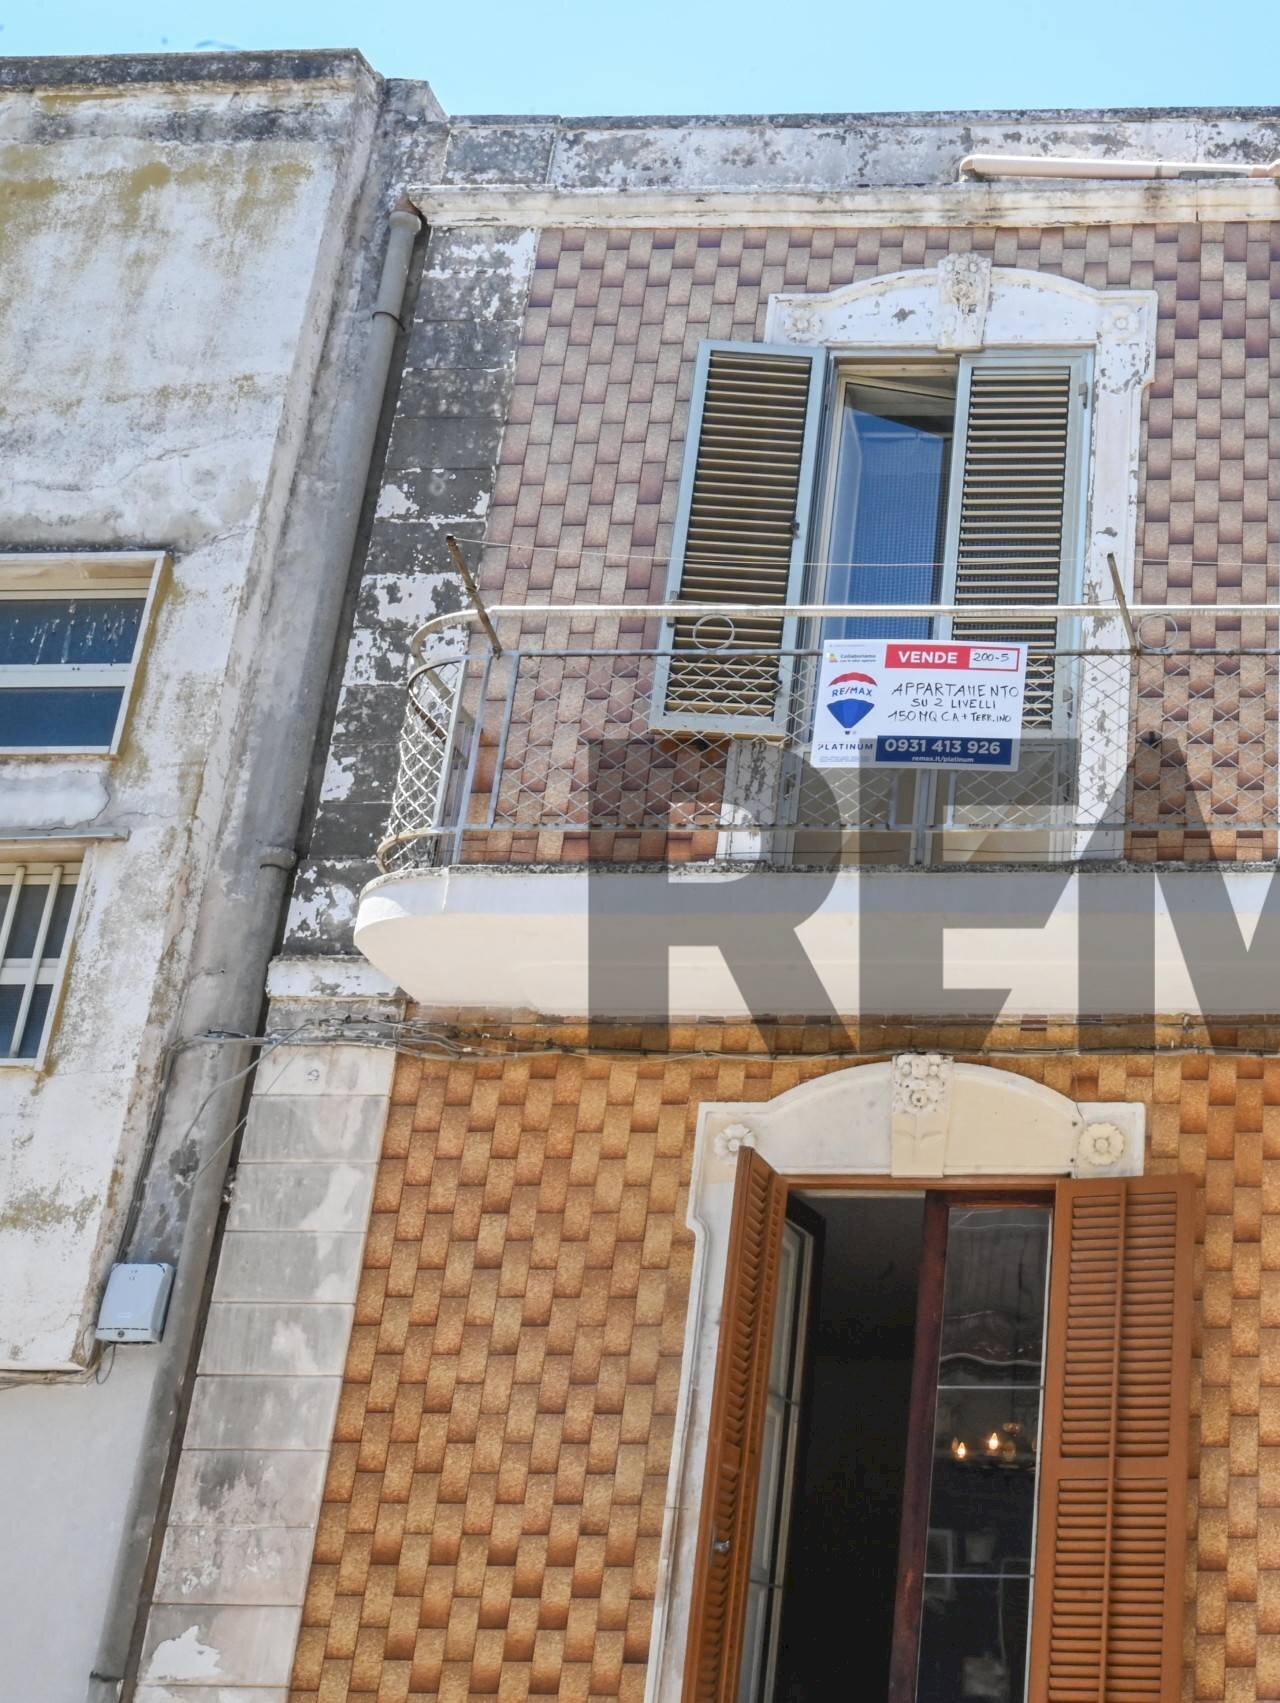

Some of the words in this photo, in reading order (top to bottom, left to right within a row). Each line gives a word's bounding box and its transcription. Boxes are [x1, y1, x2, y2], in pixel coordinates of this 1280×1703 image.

[898, 651, 958, 664] VENDE
[832, 687, 872, 697] RE/MAX
[891, 682, 1019, 698] APPARTAMENTO
[911, 698, 928, 707] SU
[934, 698, 943, 707] 2
[951, 699, 996, 709] LIVELLI
[884, 738, 926, 752] 0931
[931, 739, 962, 753] 413
[967, 740, 1000, 754] 926
[911, 755, 974, 763] remax.it/platinum
